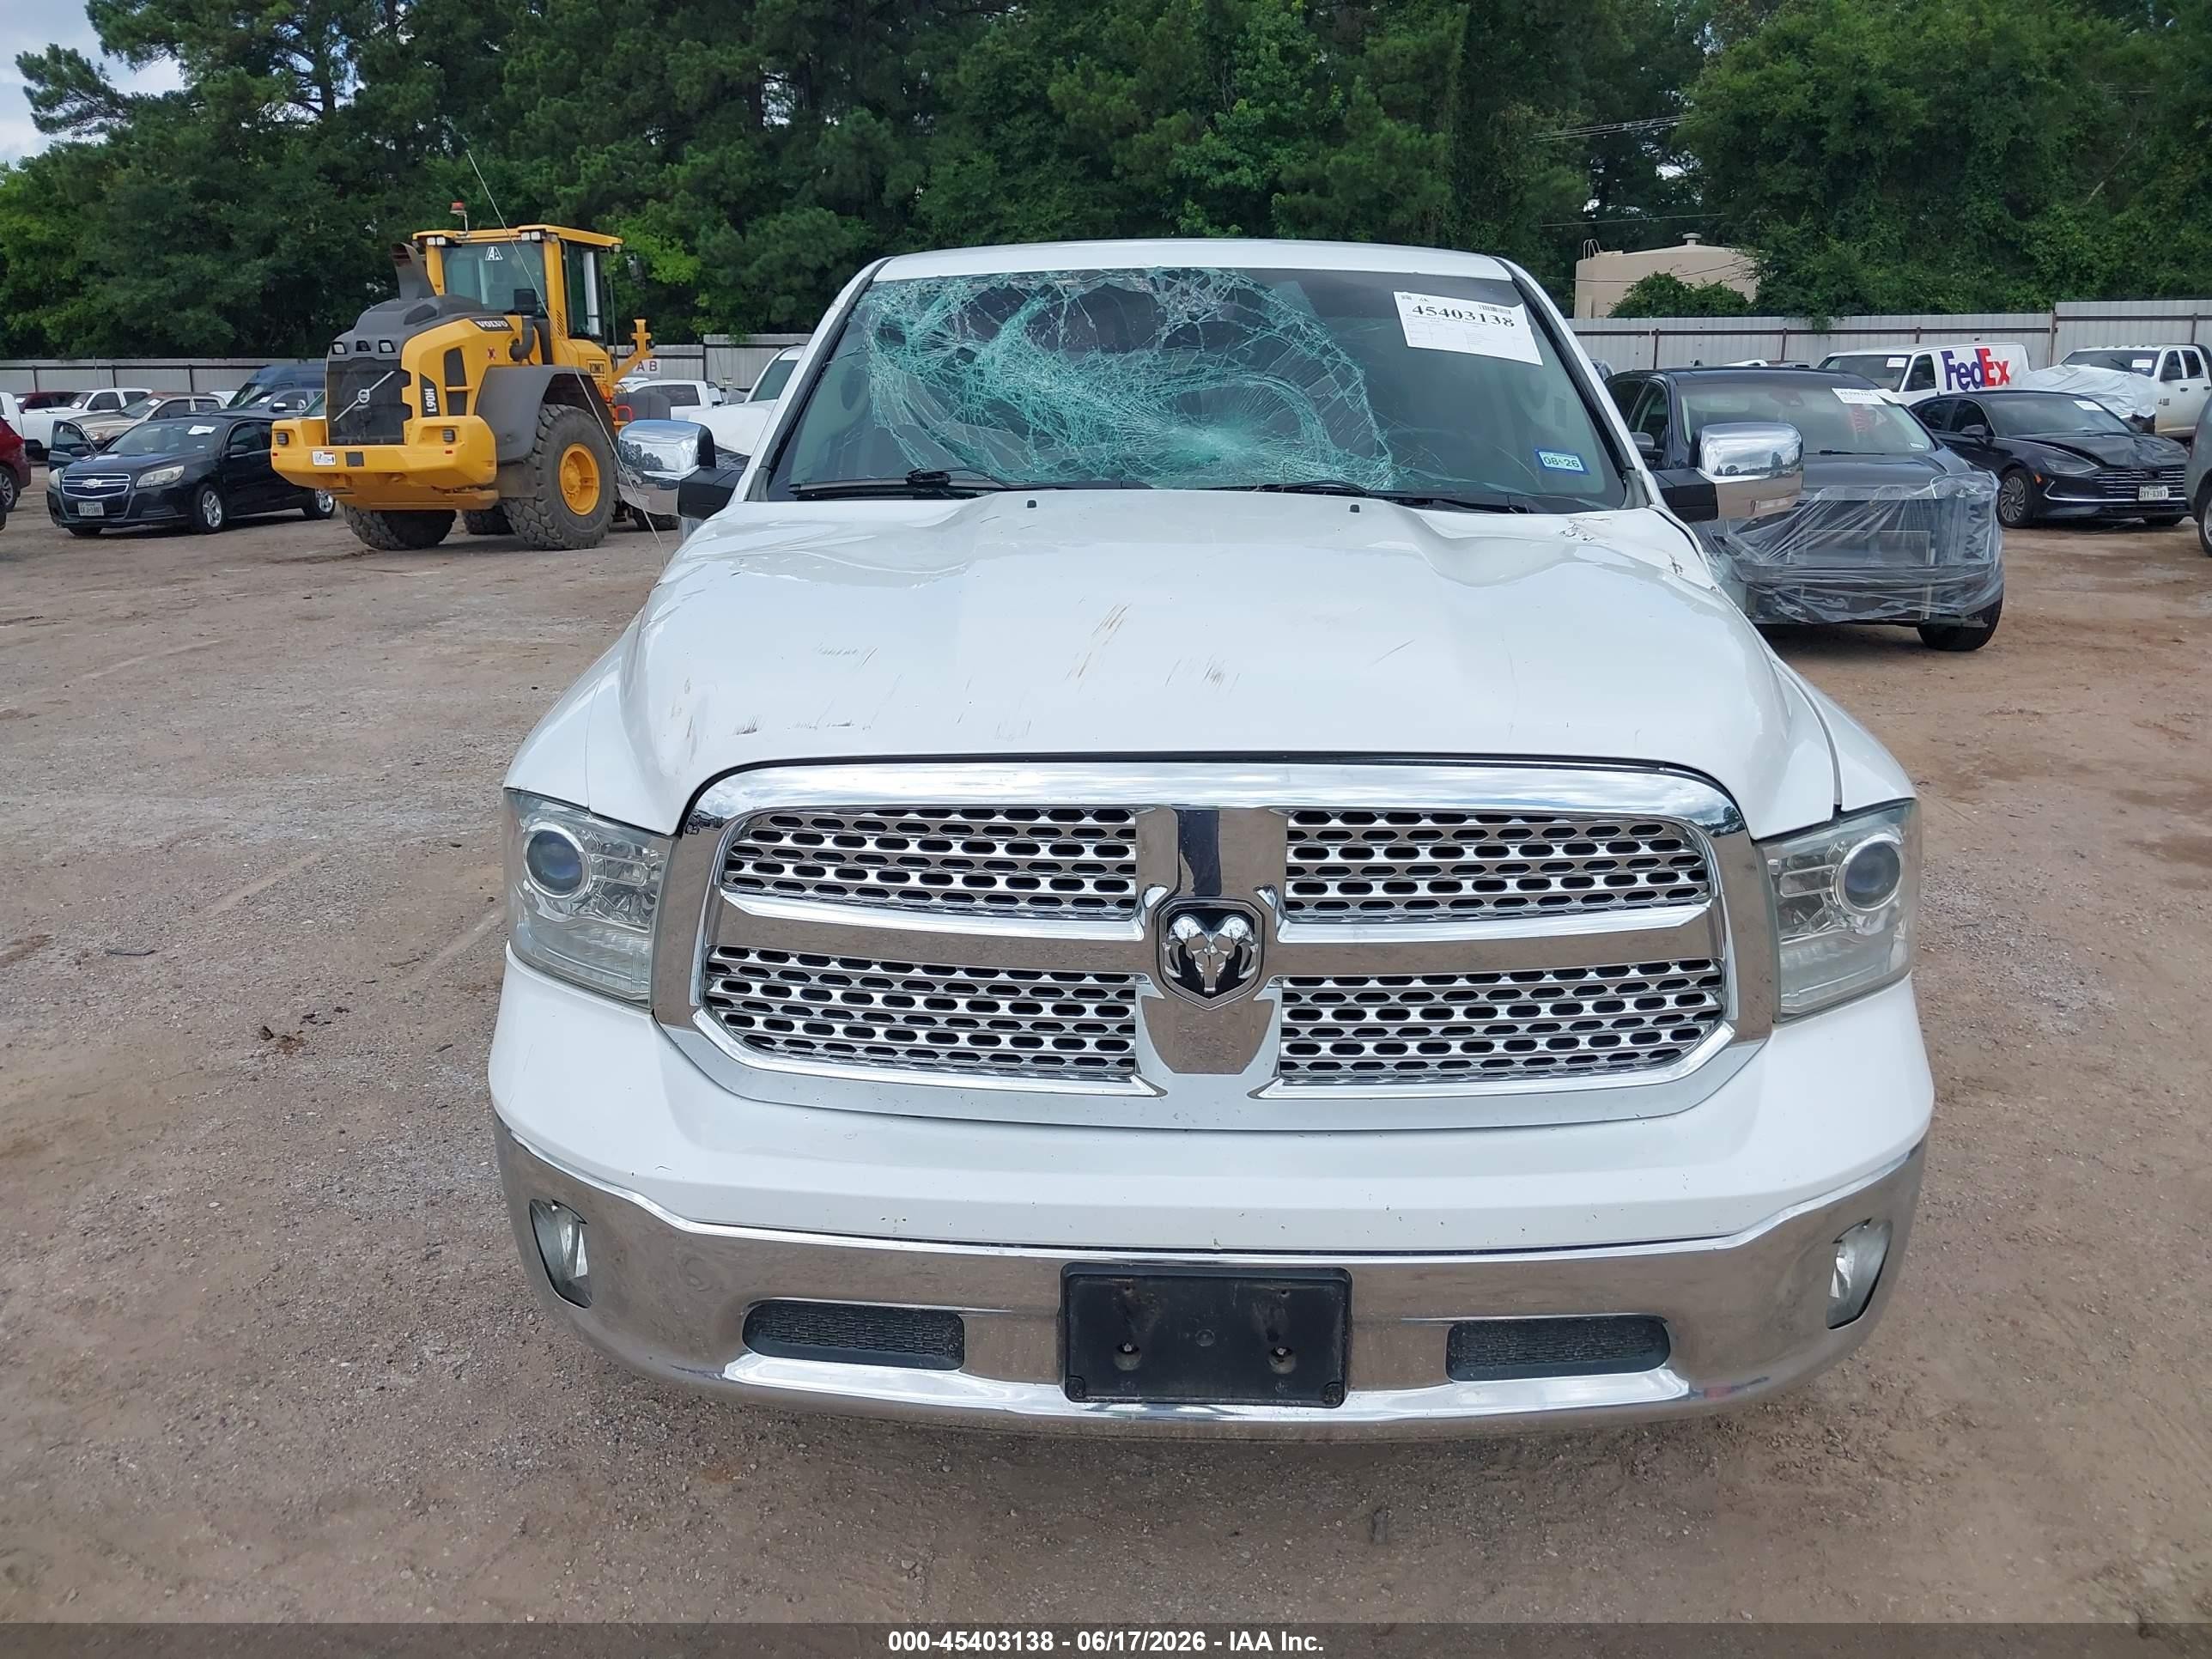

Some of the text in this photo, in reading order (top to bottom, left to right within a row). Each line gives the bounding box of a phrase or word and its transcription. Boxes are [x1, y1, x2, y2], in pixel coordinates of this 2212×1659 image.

[1412, 304, 1515, 328] 45403138
[1940, 348, 2010, 391] FedEx
[424, 387, 437, 413] L90H
